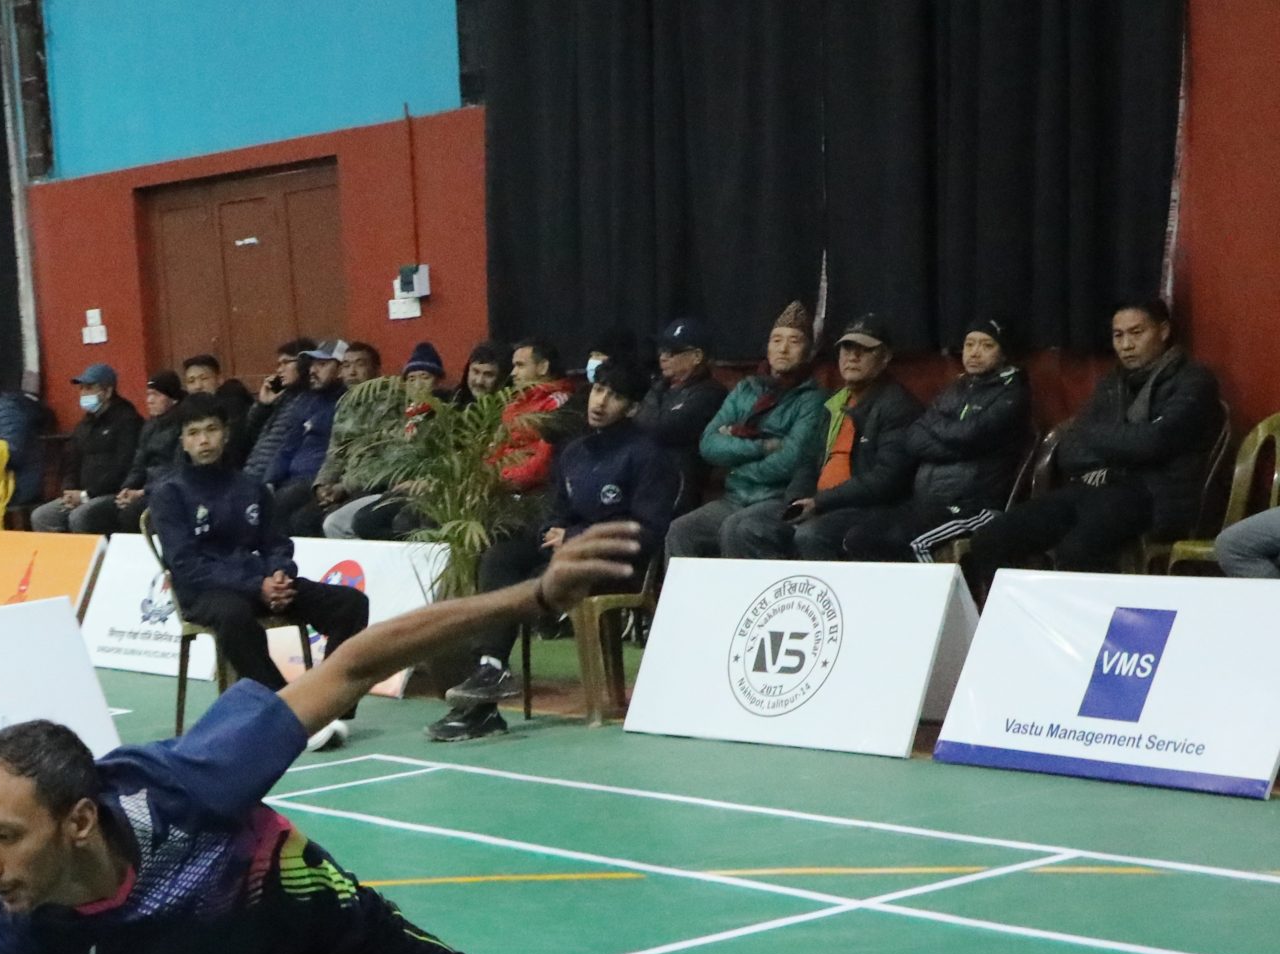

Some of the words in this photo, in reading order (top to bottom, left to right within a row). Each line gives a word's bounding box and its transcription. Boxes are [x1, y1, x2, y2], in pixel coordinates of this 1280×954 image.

[1101, 650, 1155, 678] VMS
[760, 683, 784, 697] 2077
[1004, 717, 1043, 737] Vastu
[1046, 723, 1142, 747] Management
[1145, 735, 1206, 756] Service
